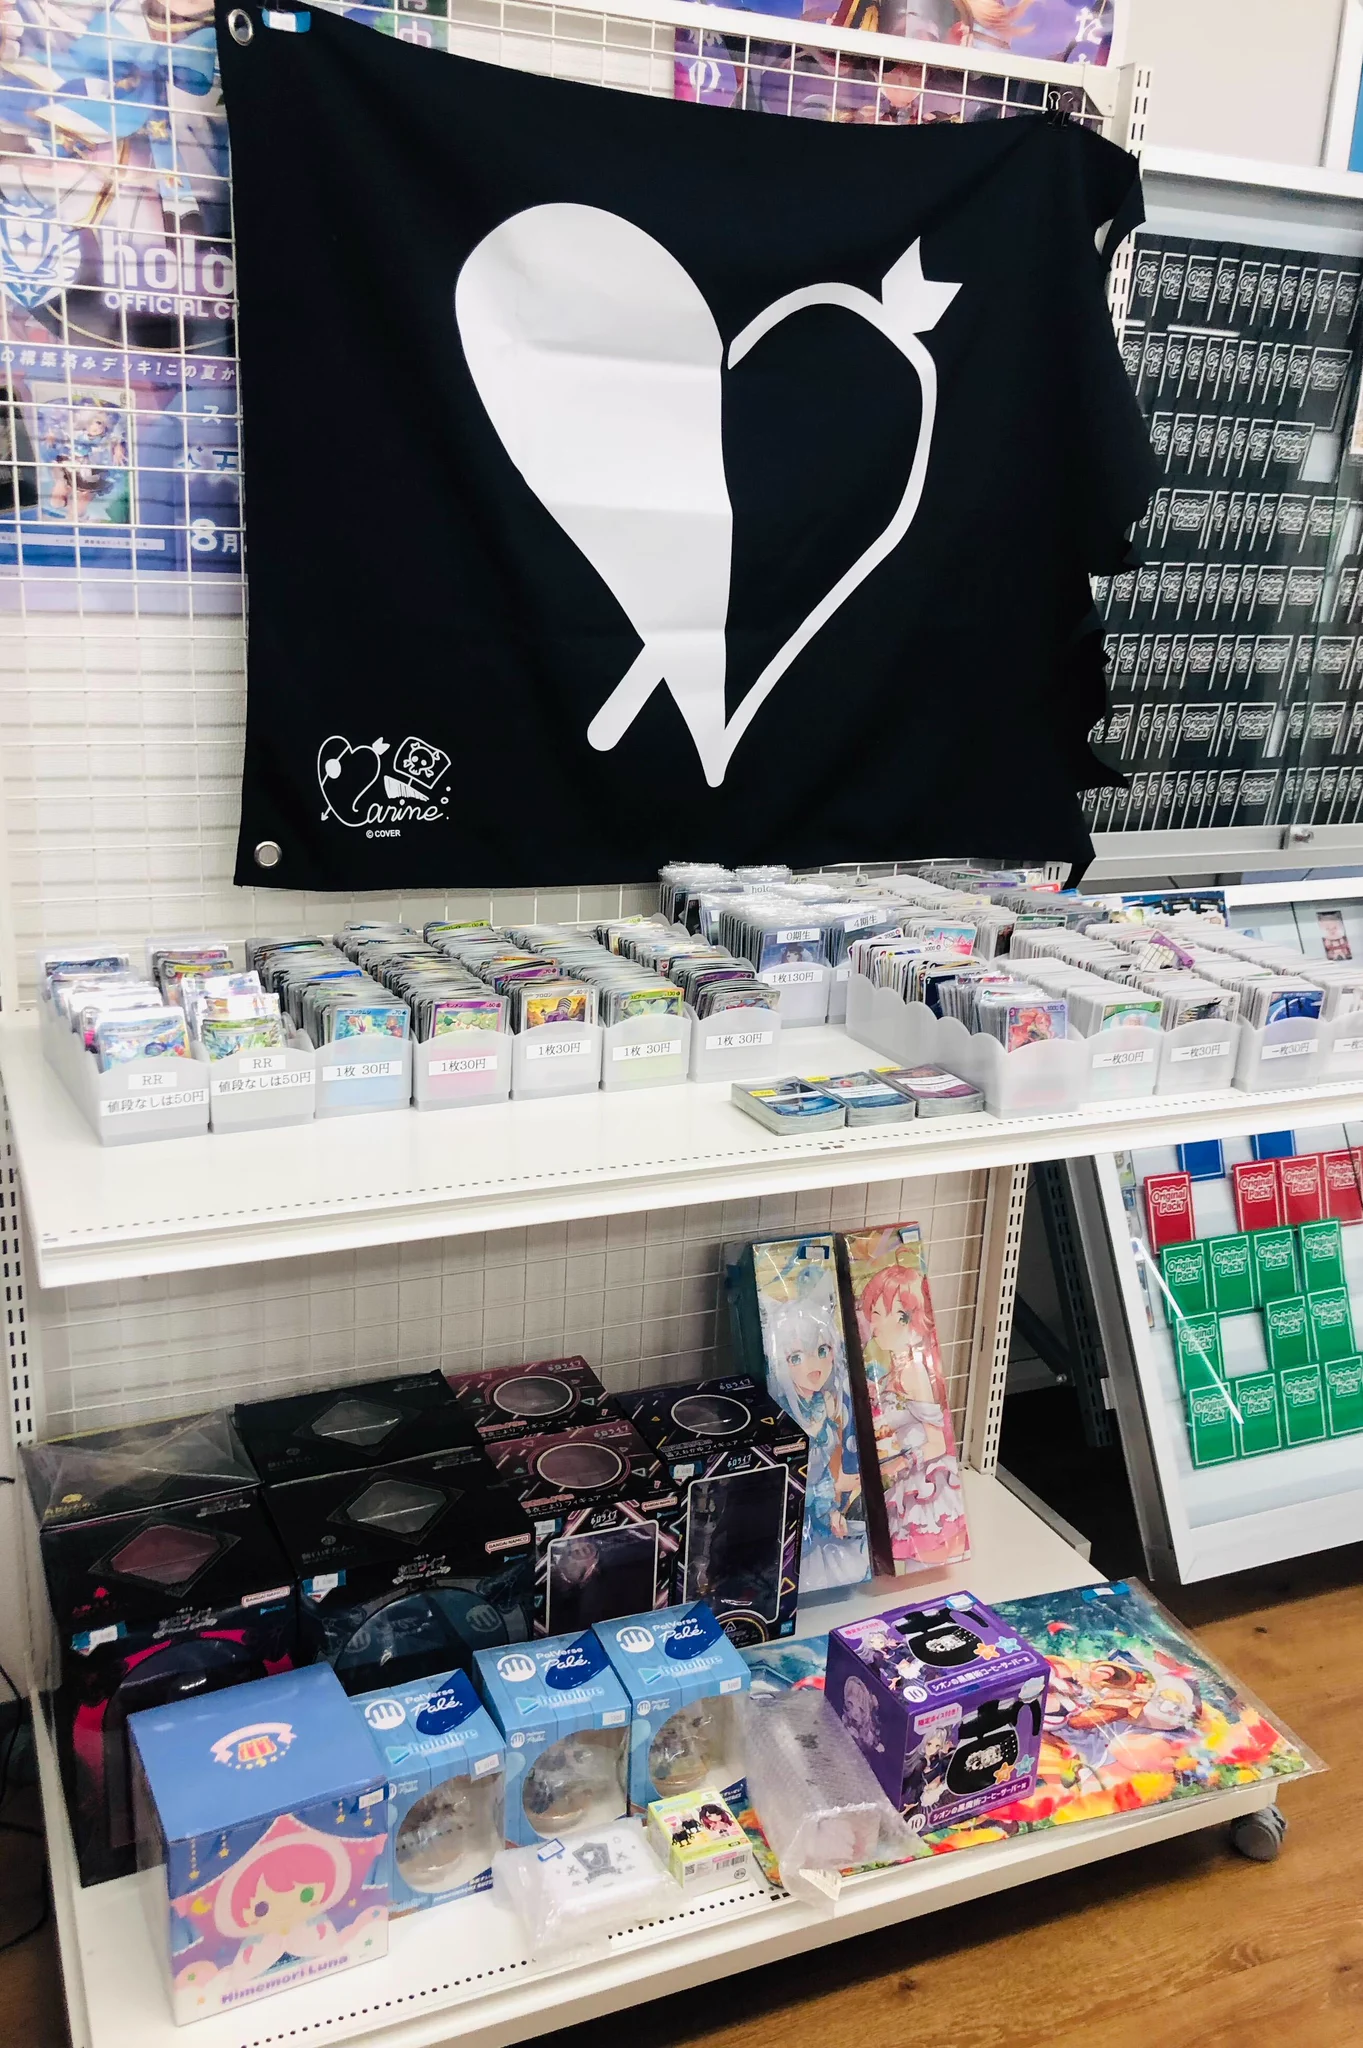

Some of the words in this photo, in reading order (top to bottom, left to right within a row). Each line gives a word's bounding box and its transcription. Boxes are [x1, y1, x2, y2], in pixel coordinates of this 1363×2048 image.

[104, 293, 209, 317] OFFICIAL
[375, 830, 401, 838] COVER
[853, 914, 877, 928] 4期生
[772, 971, 814, 984] 1枚130円
[538, 1042, 581, 1056] 1枚30円
[1181, 1044, 1221, 1058] 一枚30円
[1271, 1042, 1309, 1055] 一枚30円
[252, 1057, 272, 1069] RR
[442, 1058, 486, 1072] 1枚30円
[1103, 1051, 1144, 1065] 一枚30円
[141, 1074, 163, 1086] RR
[218, 1071, 311, 1093] 値段なしは50円
[107, 1090, 204, 1114] 値段なしは50円
[1239, 1173, 1275, 1191] Original
[1284, 1167, 1319, 1185] Original
[1248, 1187, 1272, 1200] Pack
[1292, 1181, 1316, 1193] Pack
[1151, 1186, 1187, 1204] Original
[1159, 1200, 1184, 1214] Pack
[1304, 1231, 1338, 1249] Original
[1212, 1247, 1248, 1265] Original
[1256, 1240, 1291, 1258] Original
[1312, 1246, 1335, 1259] Pack
[1167, 1254, 1203, 1273] Original
[1220, 1261, 1245, 1274] Pack
[1265, 1254, 1289, 1268] Pack
[1174, 1269, 1199, 1283] Pack
[1311, 1299, 1346, 1317] Original
[1270, 1308, 1305, 1327] Original
[1319, 1313, 1343, 1326] Pack
[1278, 1322, 1301, 1336] Pack
[1329, 1368, 1362, 1386] Original
[1285, 1377, 1319, 1396] Original
[1336, 1382, 1359, 1396] Pack
[1239, 1386, 1275, 1405] Original
[1292, 1390, 1316, 1405] Pack
[1247, 1401, 1271, 1415] Pack
[1201, 1410, 1226, 1424] Pack
[221, 1970, 305, 2005] Himemori
[308, 1955, 348, 1975] Luna
